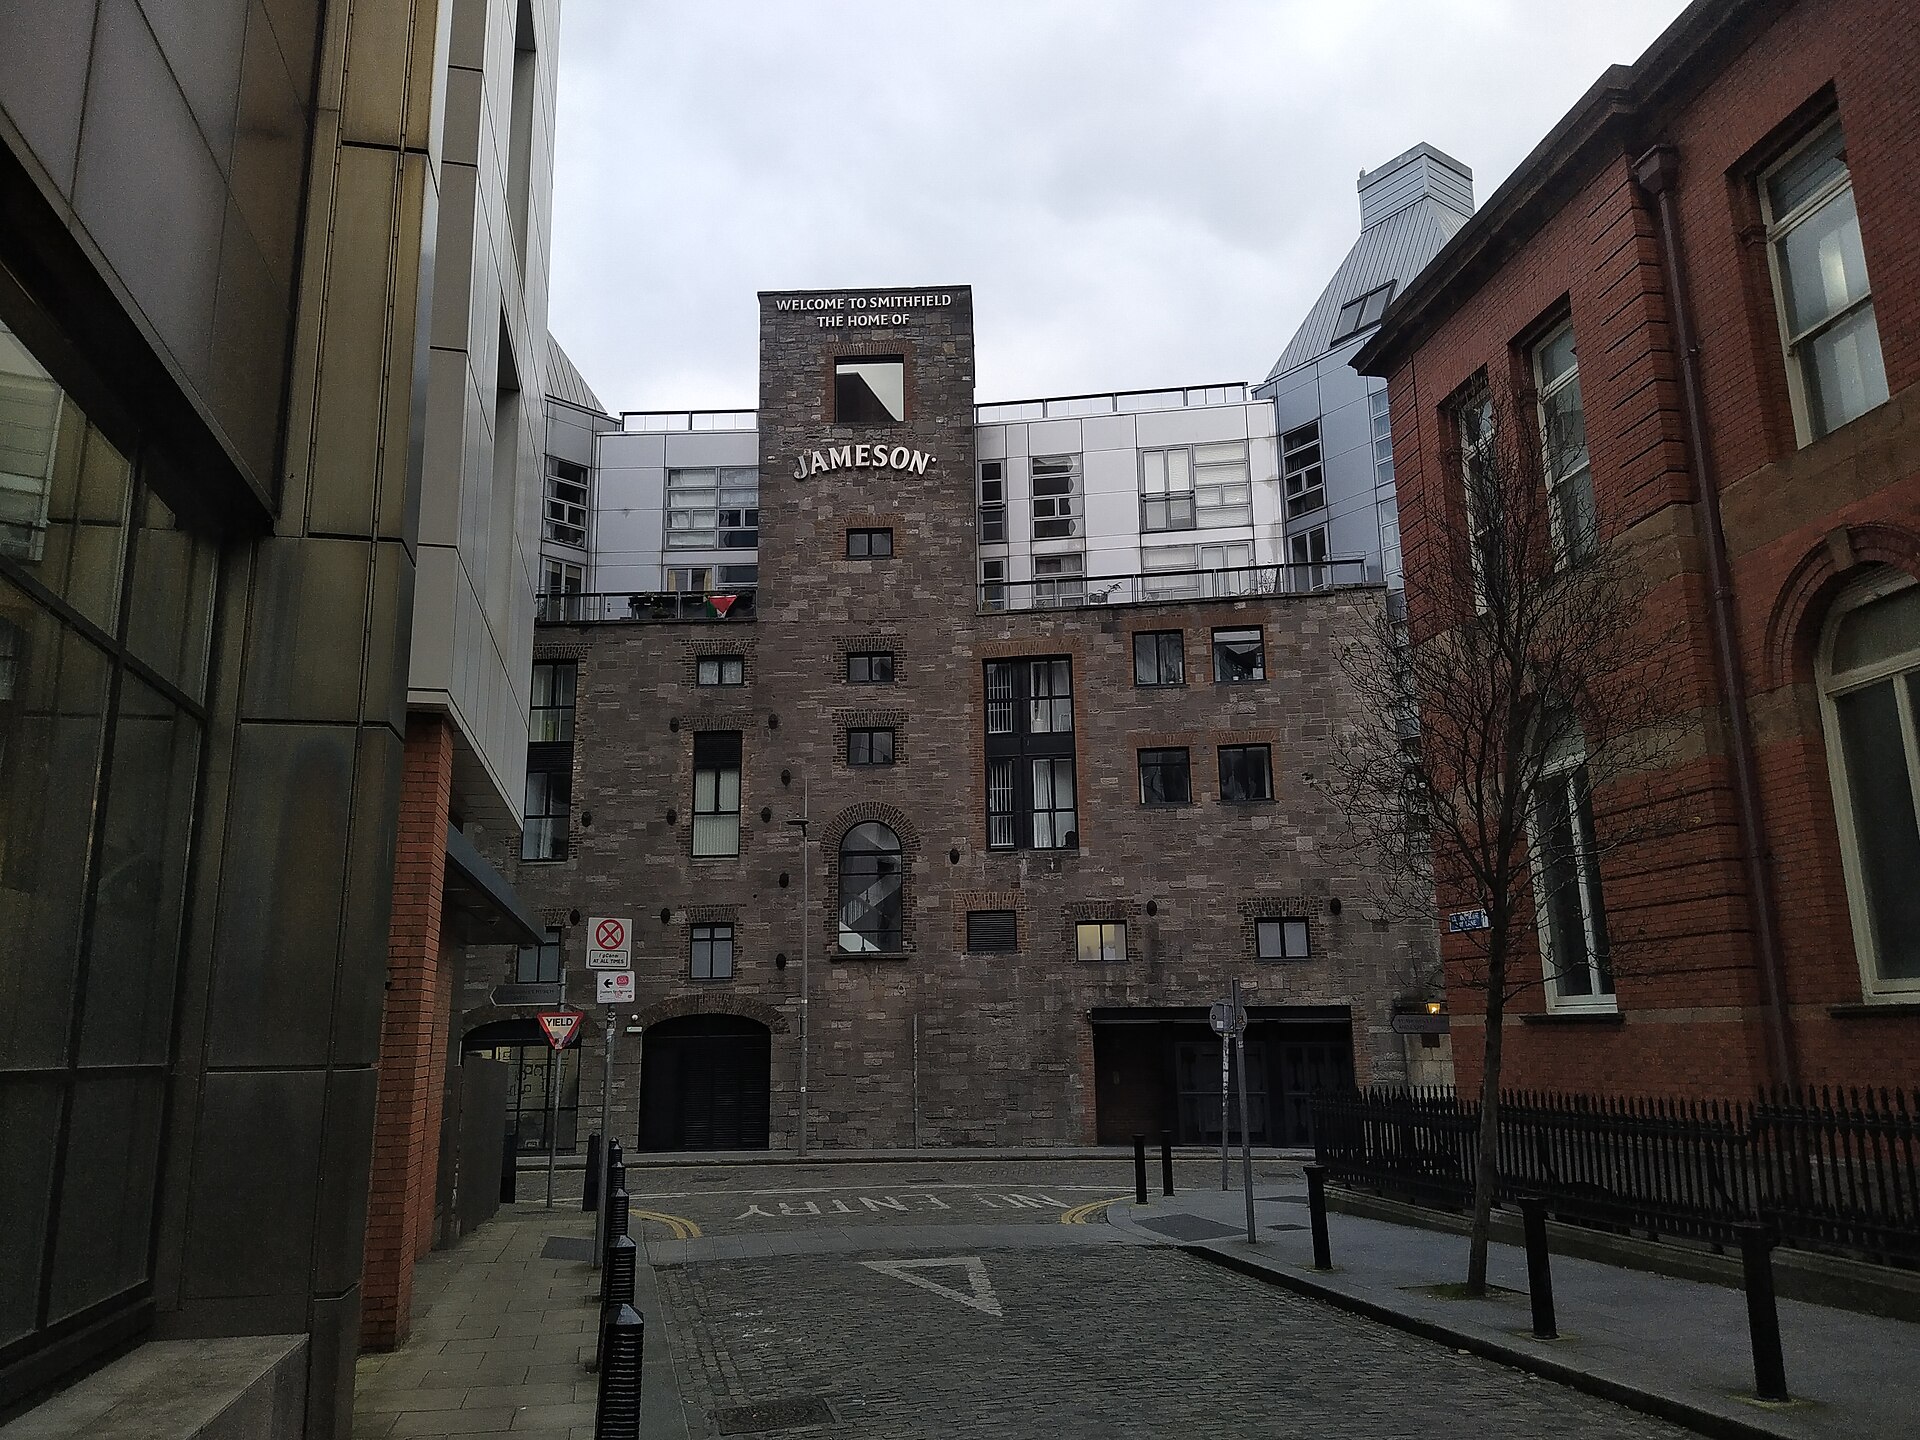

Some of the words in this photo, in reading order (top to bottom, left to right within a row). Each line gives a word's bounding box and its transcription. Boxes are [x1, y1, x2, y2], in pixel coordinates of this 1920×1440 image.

[776, 298, 845, 311] WELCOME
[849, 297, 867, 310] TO
[869, 294, 952, 308] SMITHFIELD
[817, 315, 844, 328] THE
[847, 314, 888, 327] HOME
[891, 313, 910, 325] OF
[793, 444, 931, 480] JAMESON
[546, 1018, 574, 1027] YIELD
[735, 1193, 952, 1220] ENTRY
